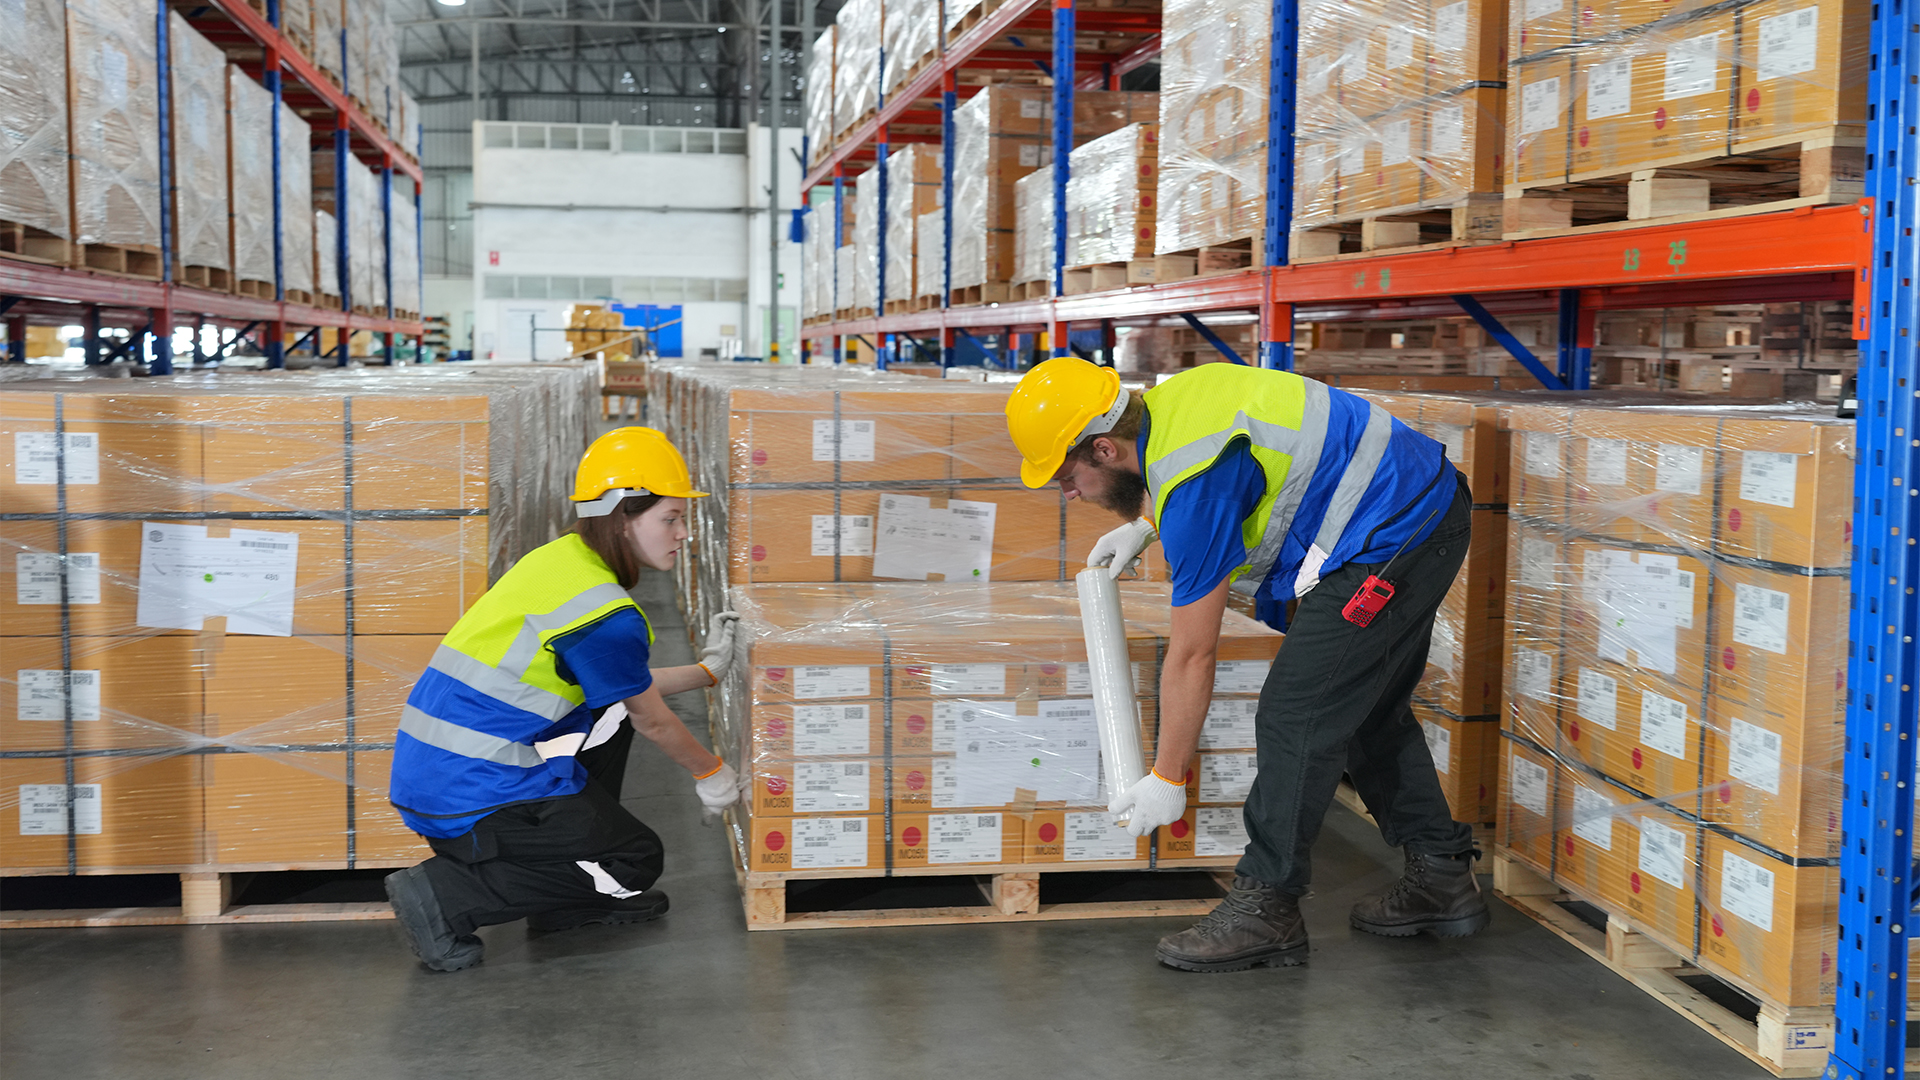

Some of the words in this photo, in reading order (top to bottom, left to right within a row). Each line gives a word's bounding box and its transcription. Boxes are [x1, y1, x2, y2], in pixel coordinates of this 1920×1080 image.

[1668, 240, 1687, 265] 25
[1623, 248, 1640, 270] 13
[763, 797, 790, 808] IMC050
[1034, 844, 1061, 855] IMC050
[1167, 841, 1193, 852] IMC050
[761, 853, 789, 864] IMC050
[898, 848, 925, 859] IMC050
